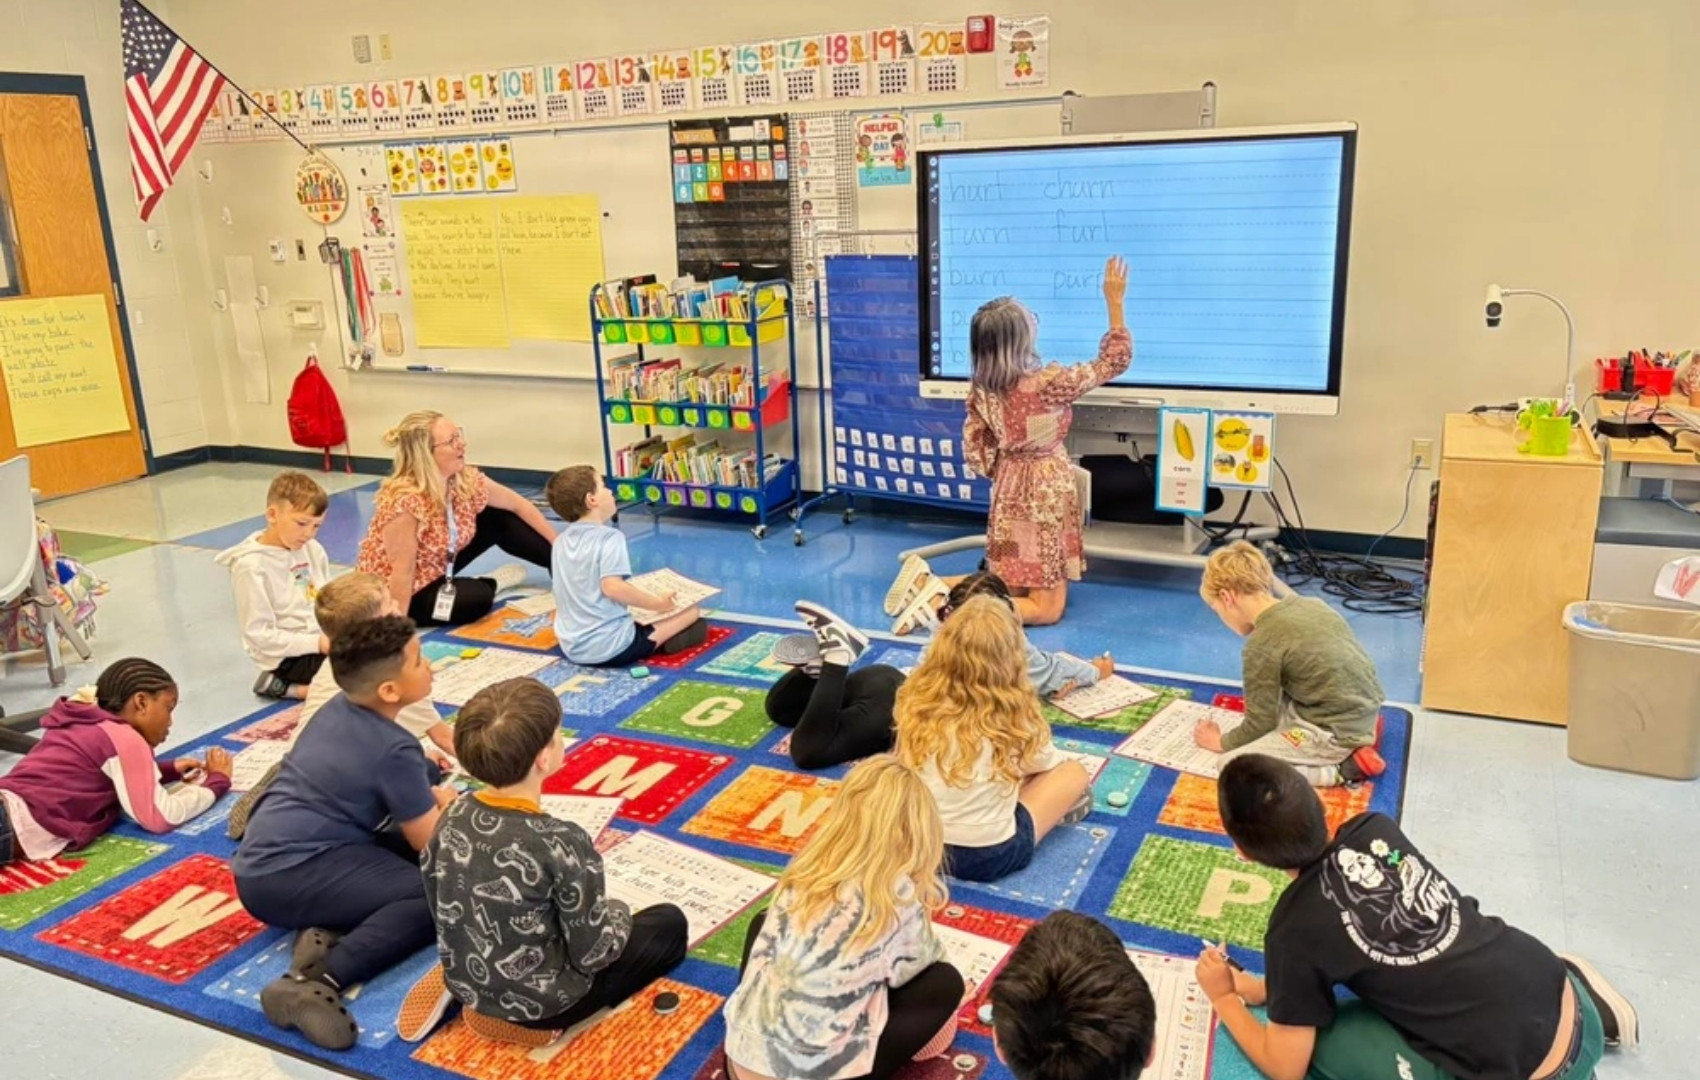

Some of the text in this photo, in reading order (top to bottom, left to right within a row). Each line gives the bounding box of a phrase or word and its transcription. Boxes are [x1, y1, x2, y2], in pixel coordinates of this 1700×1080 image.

[780, 40, 801, 70] 17
[826, 35, 848, 65] 18
[872, 30, 896, 60] 19
[920, 30, 948, 56] 20
[614, 58, 635, 86] 13
[654, 54, 675, 81] 14
[693, 49, 717, 77] 15
[737, 47, 759, 74] 16
[470, 74, 484, 98] 9
[502, 72, 521, 98] 10
[543, 66, 553, 93] 11
[576, 62, 596, 90] 12
[281, 90, 292, 113] 3
[310, 88, 322, 110] 4
[340, 86, 352, 110] 5
[372, 84, 384, 108] 6
[403, 80, 414, 104] 7
[436, 78, 448, 102] 8
[863, 122, 898, 134] HELPER
[696, 166, 703, 178] 2
[711, 166, 717, 177] 3
[727, 166, 734, 176] 4
[743, 165, 751, 177] 5
[778, 164, 784, 176] 7
[948, 170, 1114, 202] hurt churn
[944, 208, 1110, 246] turn furl
[948, 256, 1007, 286] burn
[681, 696, 744, 727] G
[572, 754, 678, 800] M
[747, 790, 832, 838] N
[1197, 868, 1274, 919] P
[120, 884, 247, 949] W
